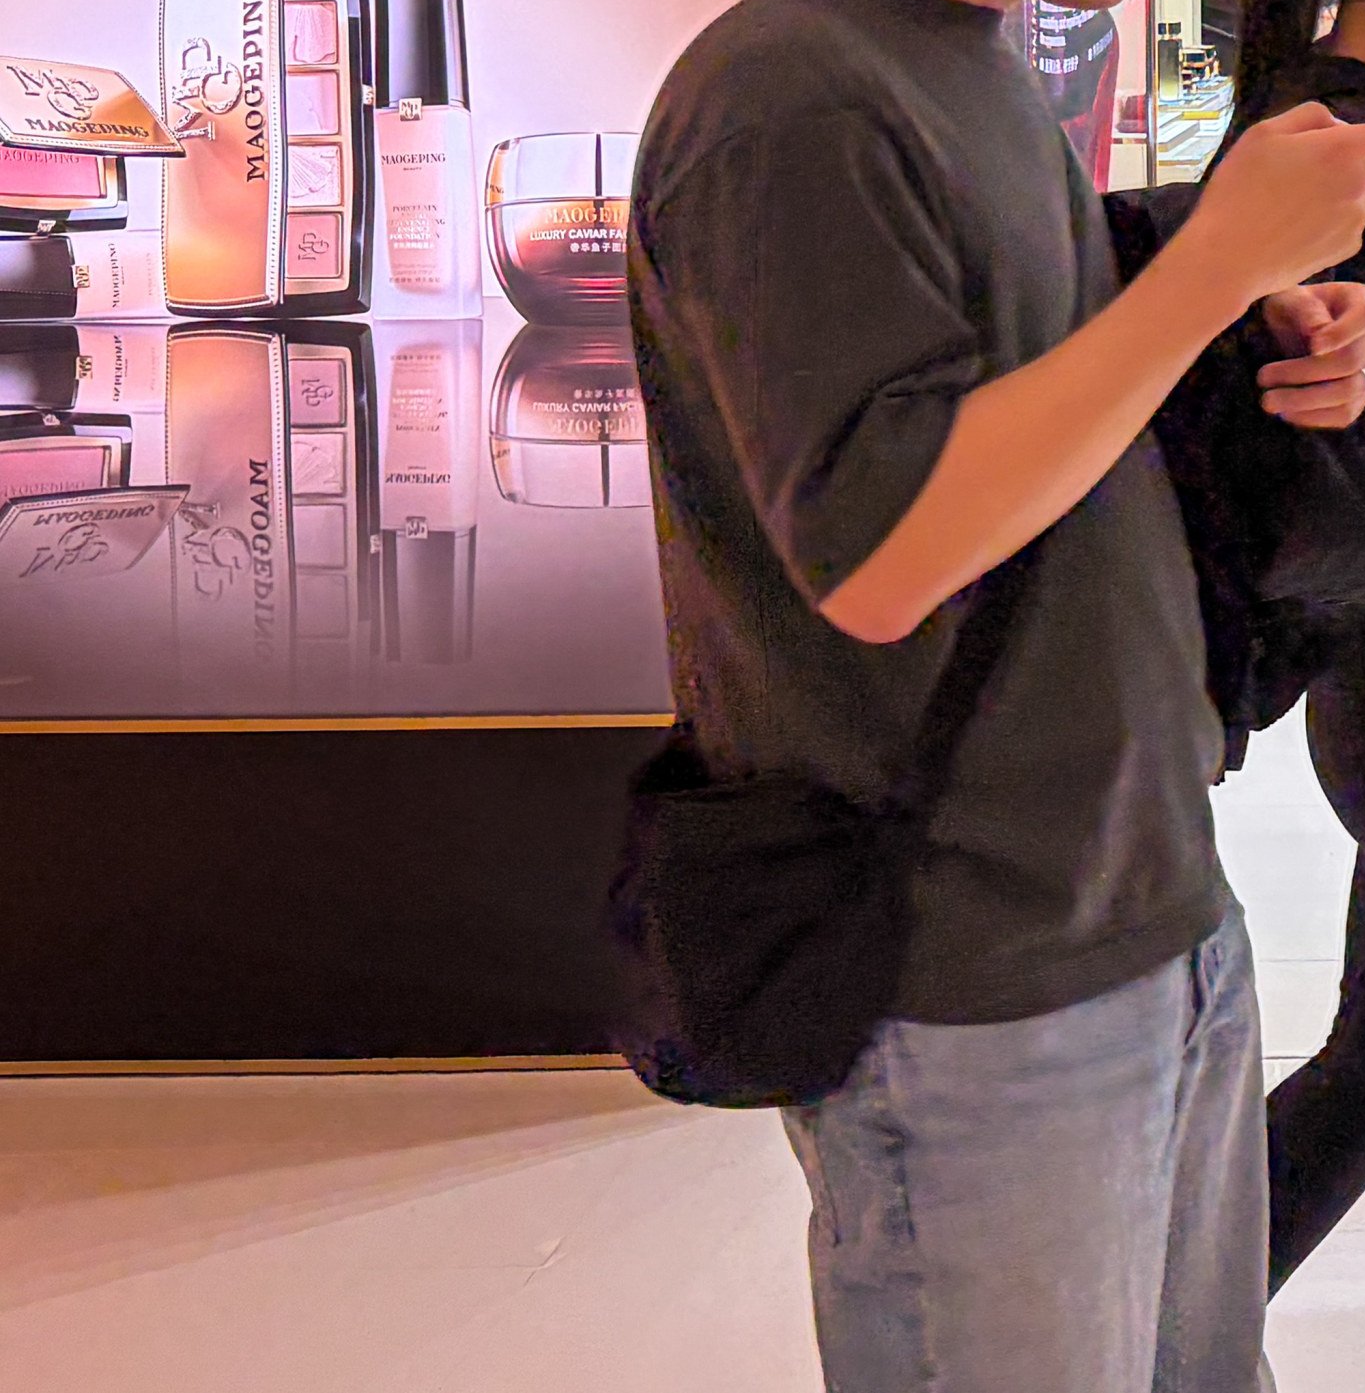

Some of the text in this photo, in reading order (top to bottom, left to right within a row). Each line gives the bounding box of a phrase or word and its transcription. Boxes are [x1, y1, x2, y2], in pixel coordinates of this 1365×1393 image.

[25, 118, 150, 138] MAOGEPING
[381, 153, 446, 166] MAOGEPING
[529, 230, 567, 241] LUXURY
[568, 228, 607, 239] CAVIAR
